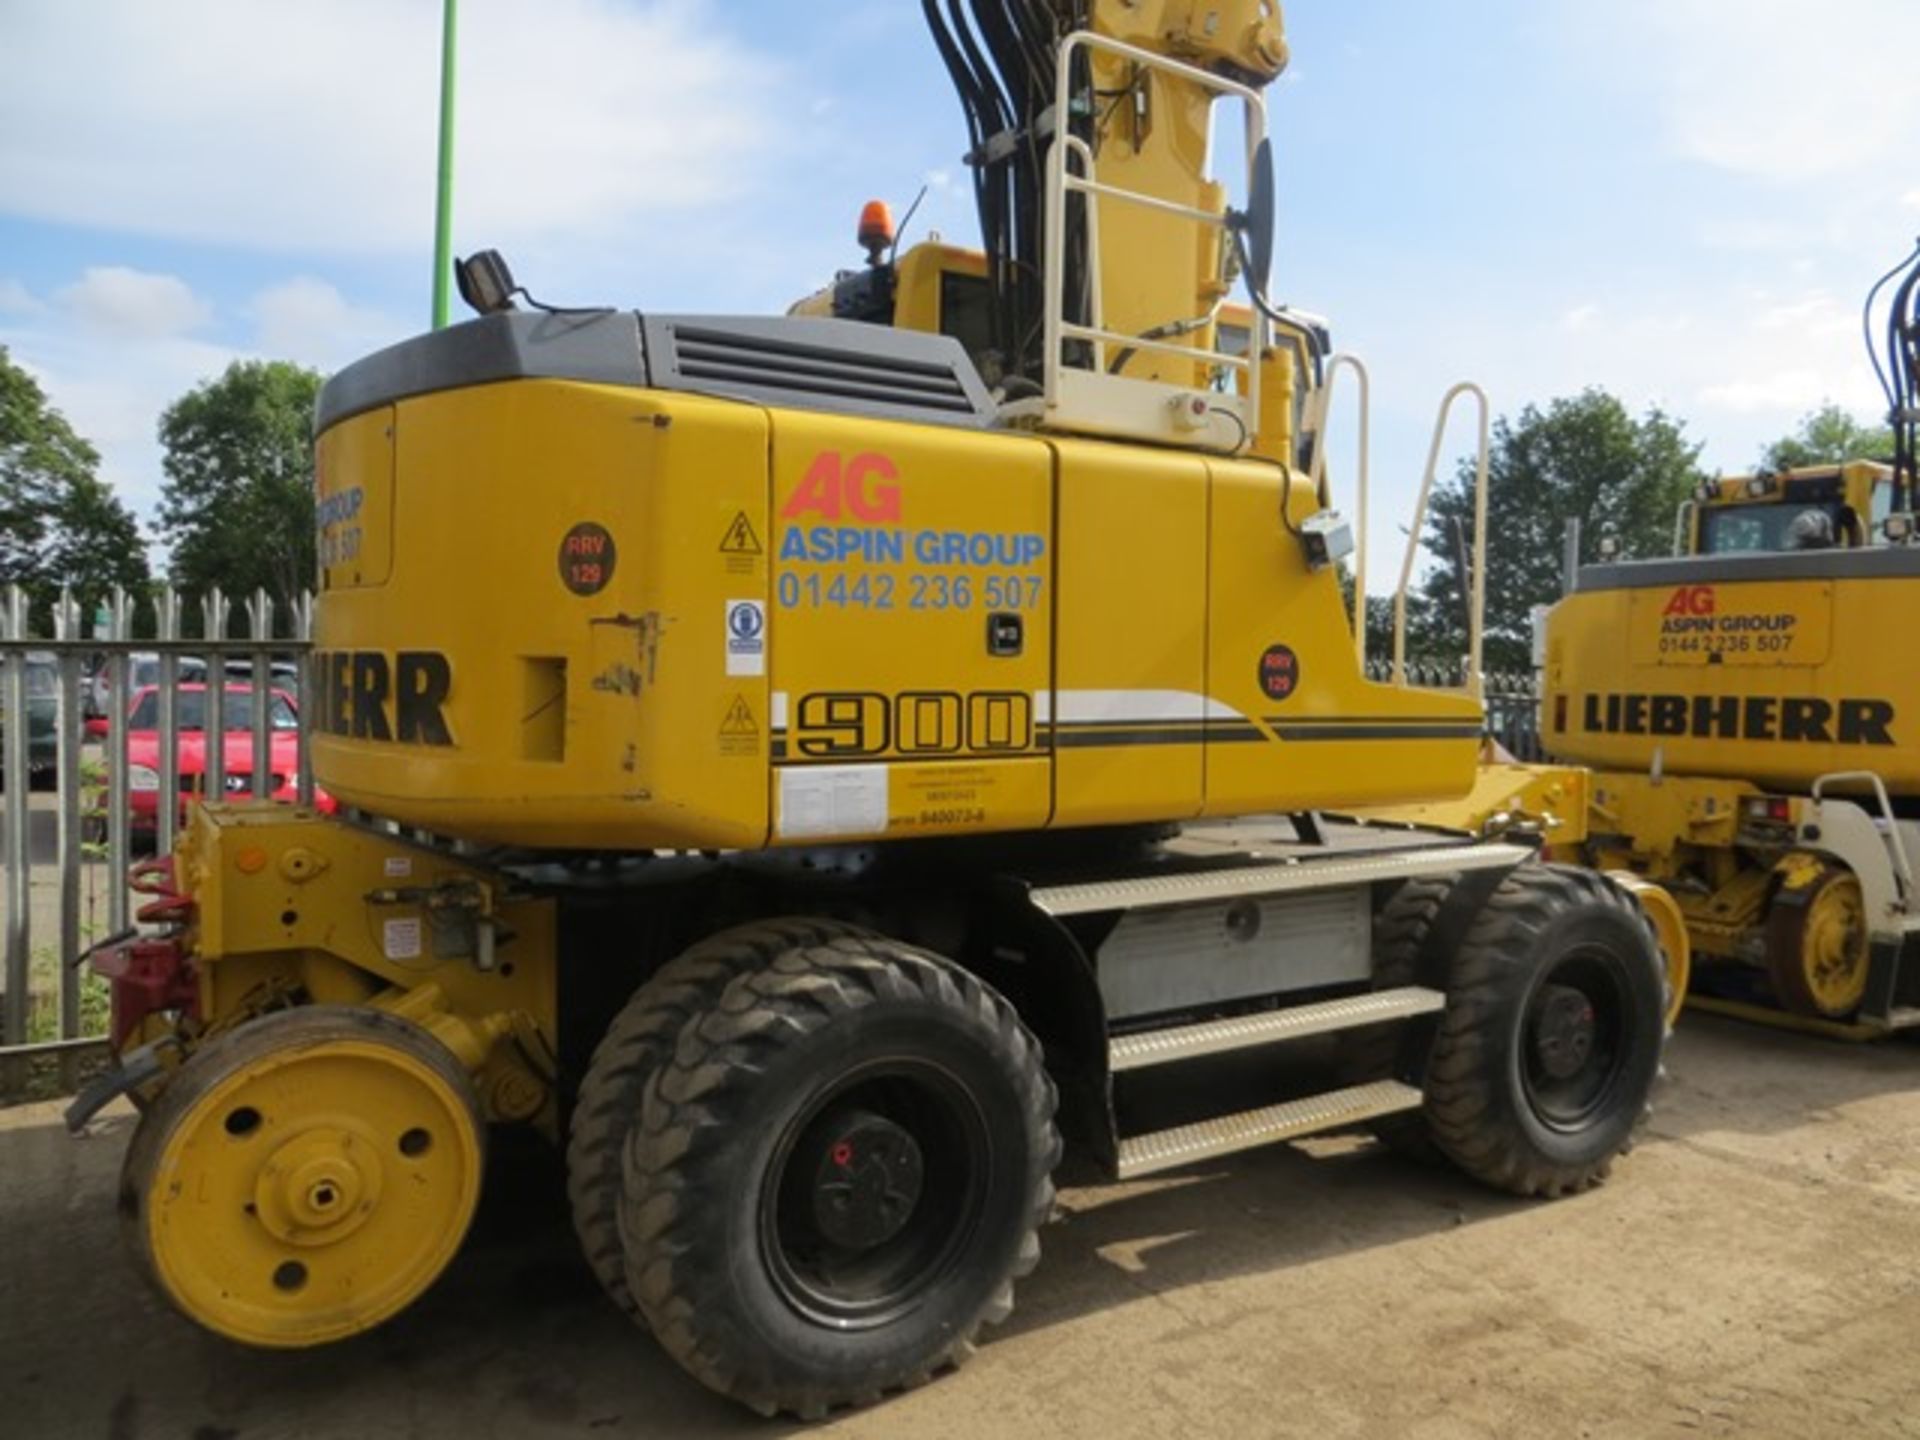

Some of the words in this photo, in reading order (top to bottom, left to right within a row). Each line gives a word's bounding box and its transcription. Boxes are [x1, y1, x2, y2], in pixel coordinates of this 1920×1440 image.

[782, 450, 902, 522] AG
[779, 526, 904, 563] ASPIN
[914, 530, 1045, 566] GROUP
[778, 571, 895, 609] 01442
[908, 575, 972, 609] 236
[983, 576, 1043, 609] 507
[1663, 587, 1715, 616] AG
[1661, 617, 1714, 633] ASPIN
[1720, 614, 1796, 632] GROUP
[1757, 635, 1794, 652] 507
[797, 691, 1031, 757] 900
[1583, 693, 1896, 746] LIEBHERR
